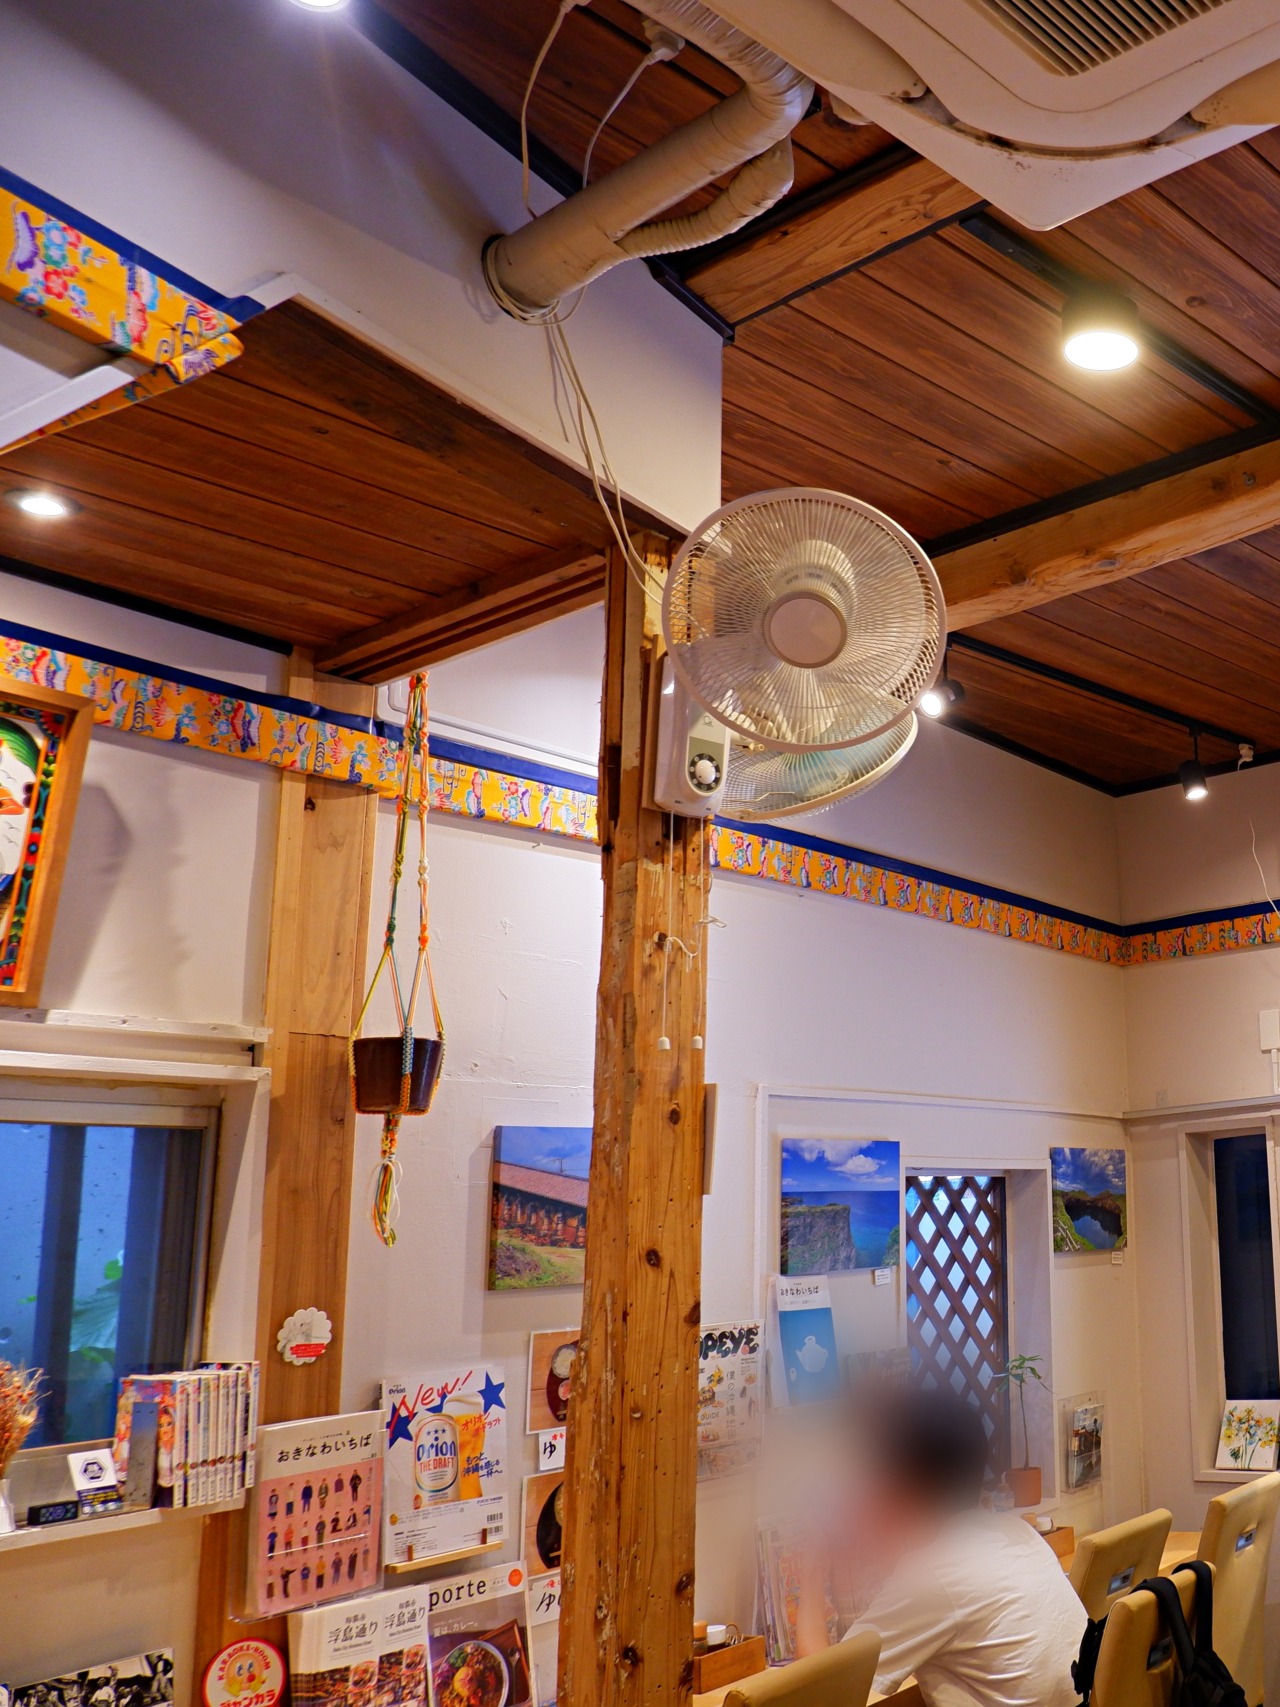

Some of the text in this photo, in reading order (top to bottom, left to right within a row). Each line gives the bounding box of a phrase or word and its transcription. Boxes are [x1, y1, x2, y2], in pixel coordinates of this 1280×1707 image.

[277, 1432, 373, 1463] おきなわいちば
[420, 1457, 455, 1473] THE DRAFT
[428, 1579, 487, 1613] porte
[383, 1606, 426, 1630] 浮島通り
[327, 1621, 378, 1645] 浮島通り
